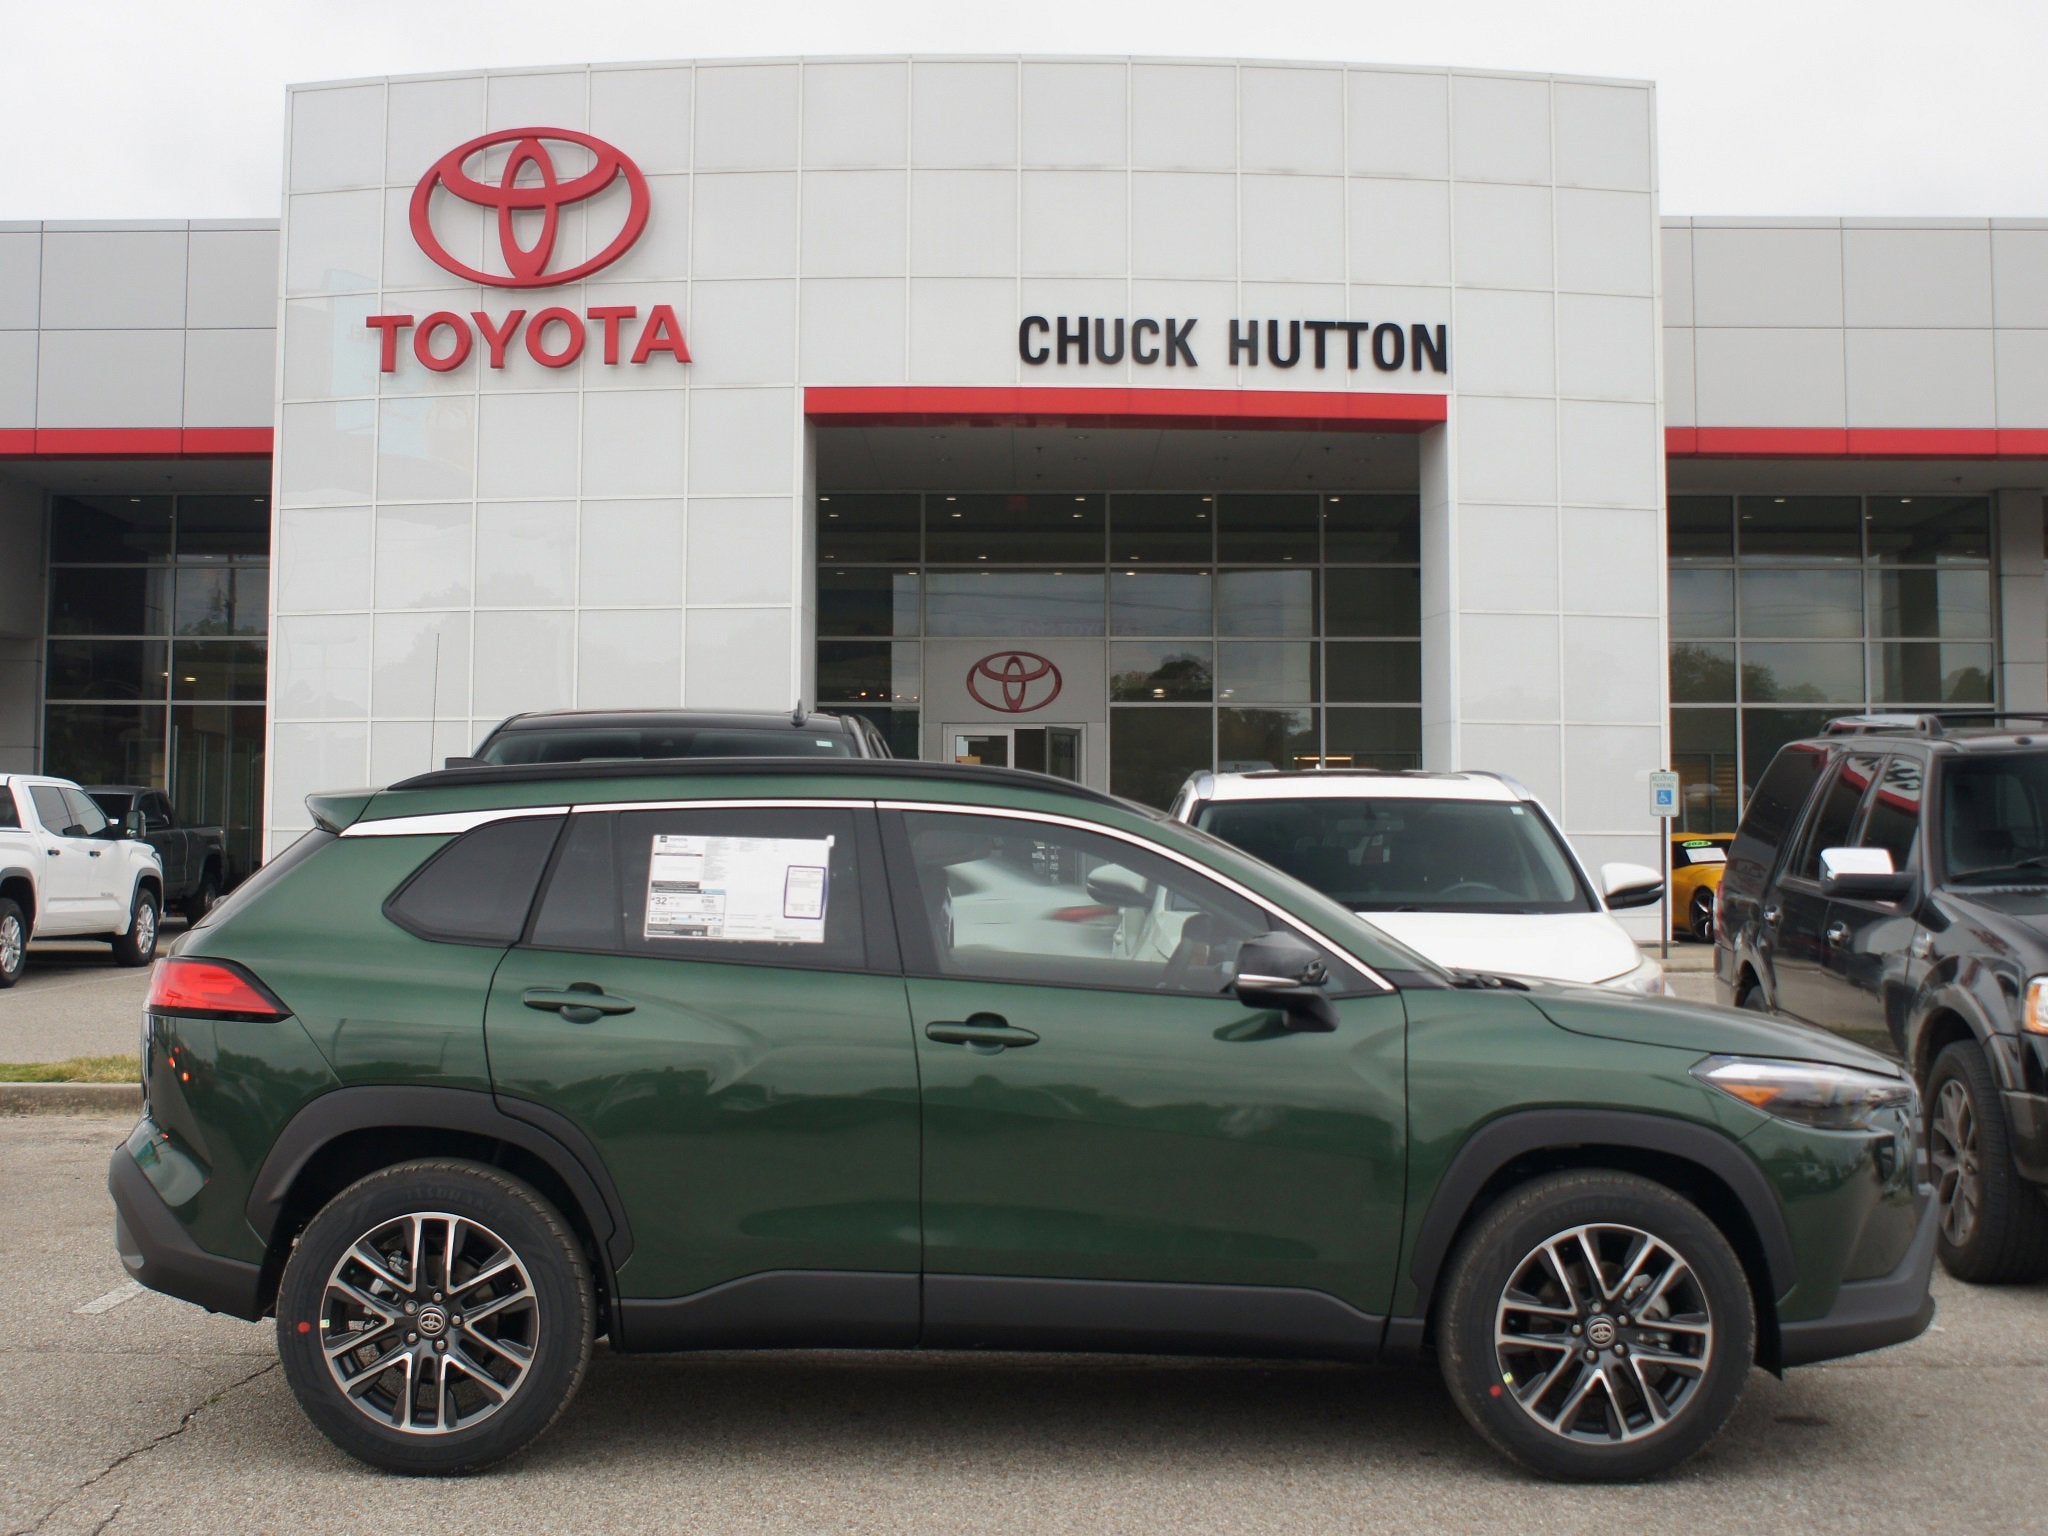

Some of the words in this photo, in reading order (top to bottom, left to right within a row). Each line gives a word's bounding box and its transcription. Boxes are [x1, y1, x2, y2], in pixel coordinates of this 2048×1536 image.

[366, 304, 692, 373] TOYOTA
[1018, 315, 1199, 367] CHUCK
[1229, 319, 1448, 374] HUTTON
